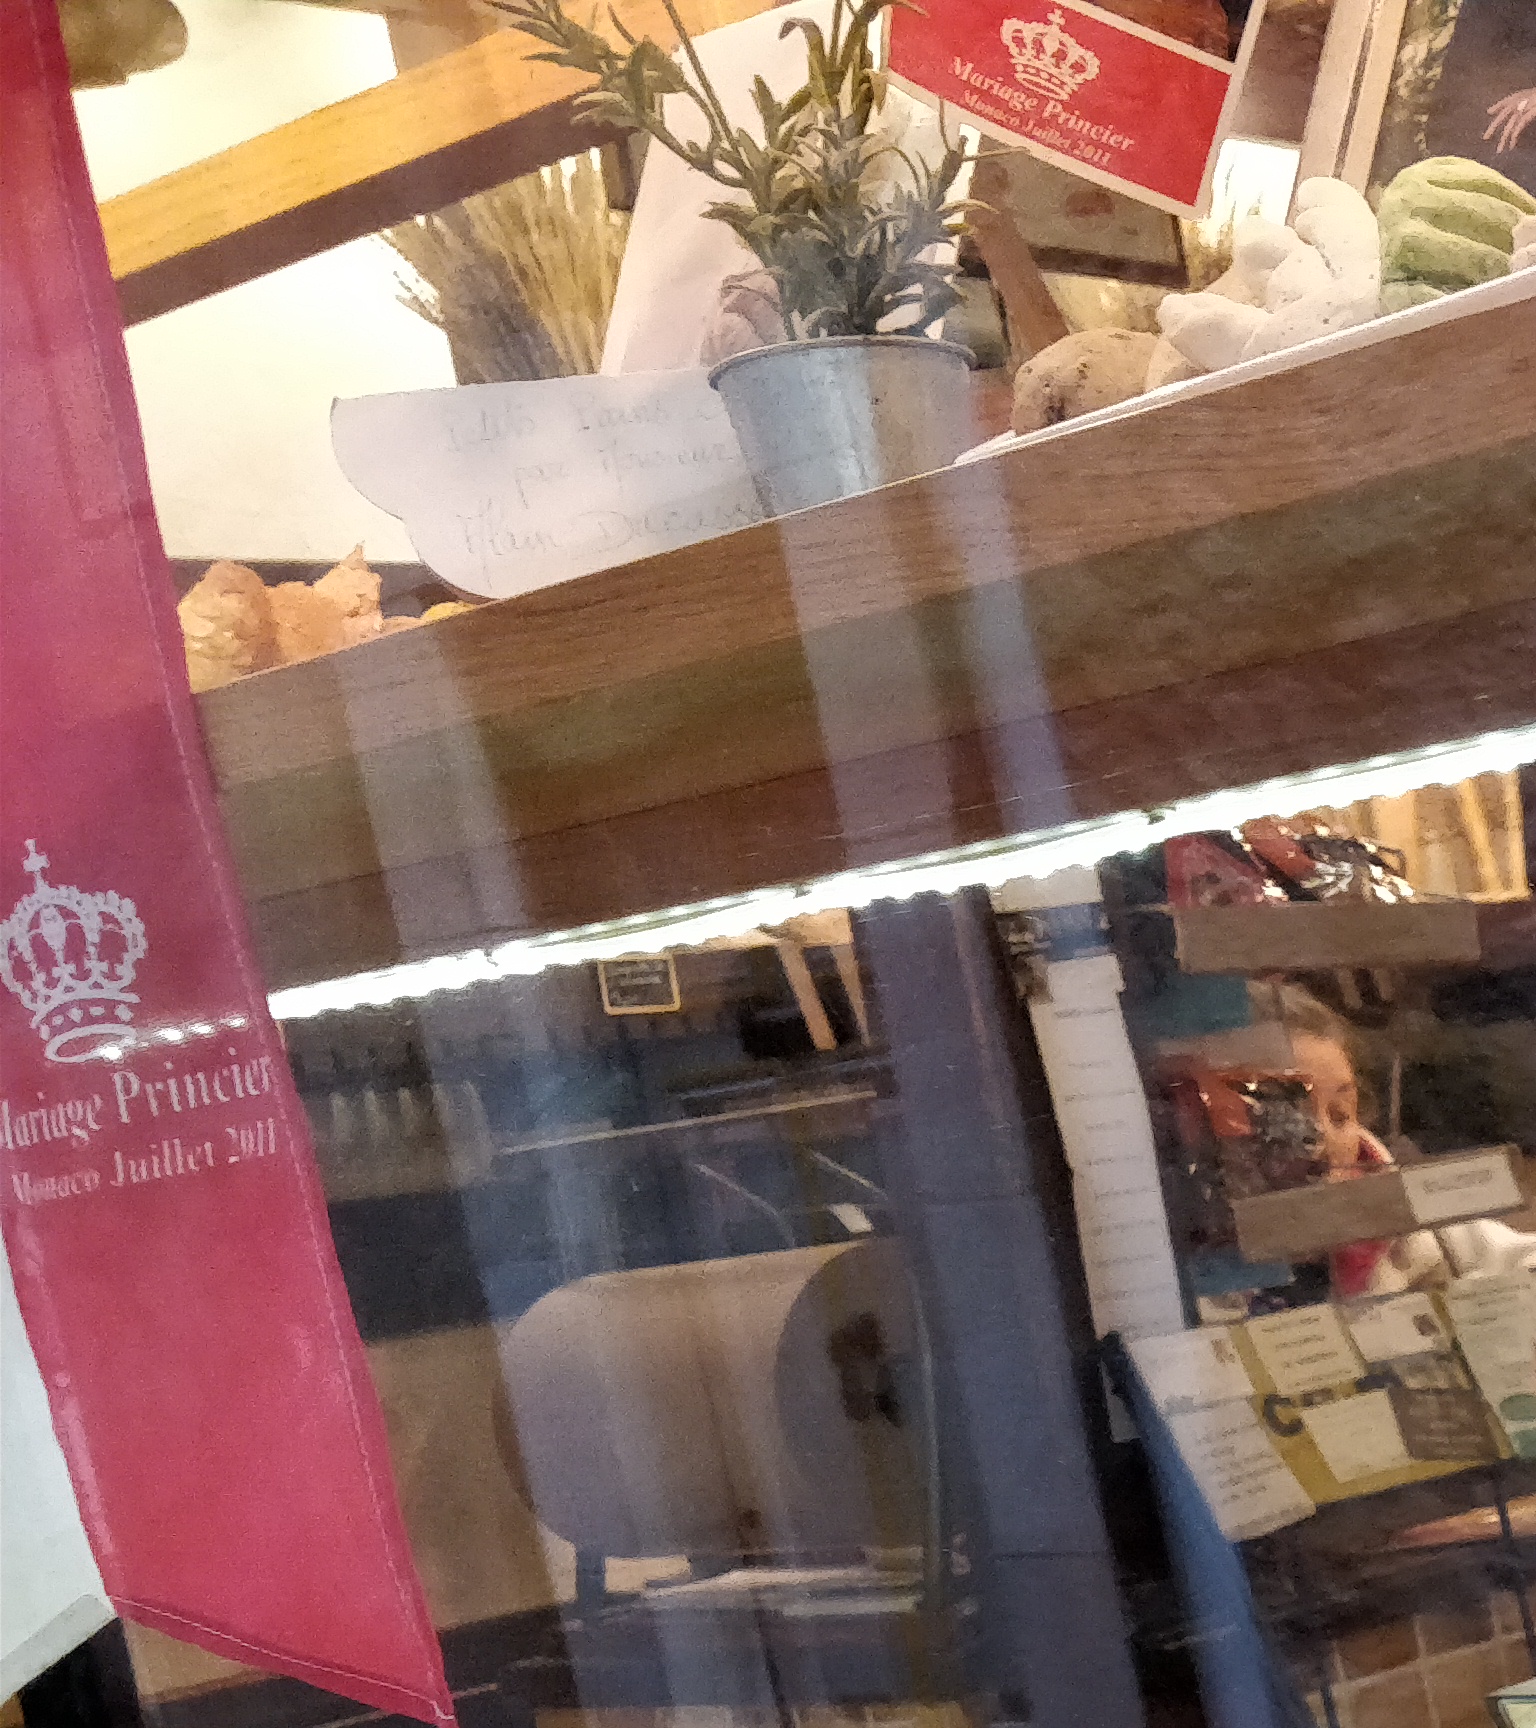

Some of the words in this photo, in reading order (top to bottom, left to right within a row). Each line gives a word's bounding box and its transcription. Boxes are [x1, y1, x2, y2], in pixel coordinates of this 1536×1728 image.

[949, 56, 1039, 111] Mariage
[1042, 99, 1135, 150] Princier
[112, 1046, 272, 1123] Princier
[109, 1137, 215, 1187] Juillet
